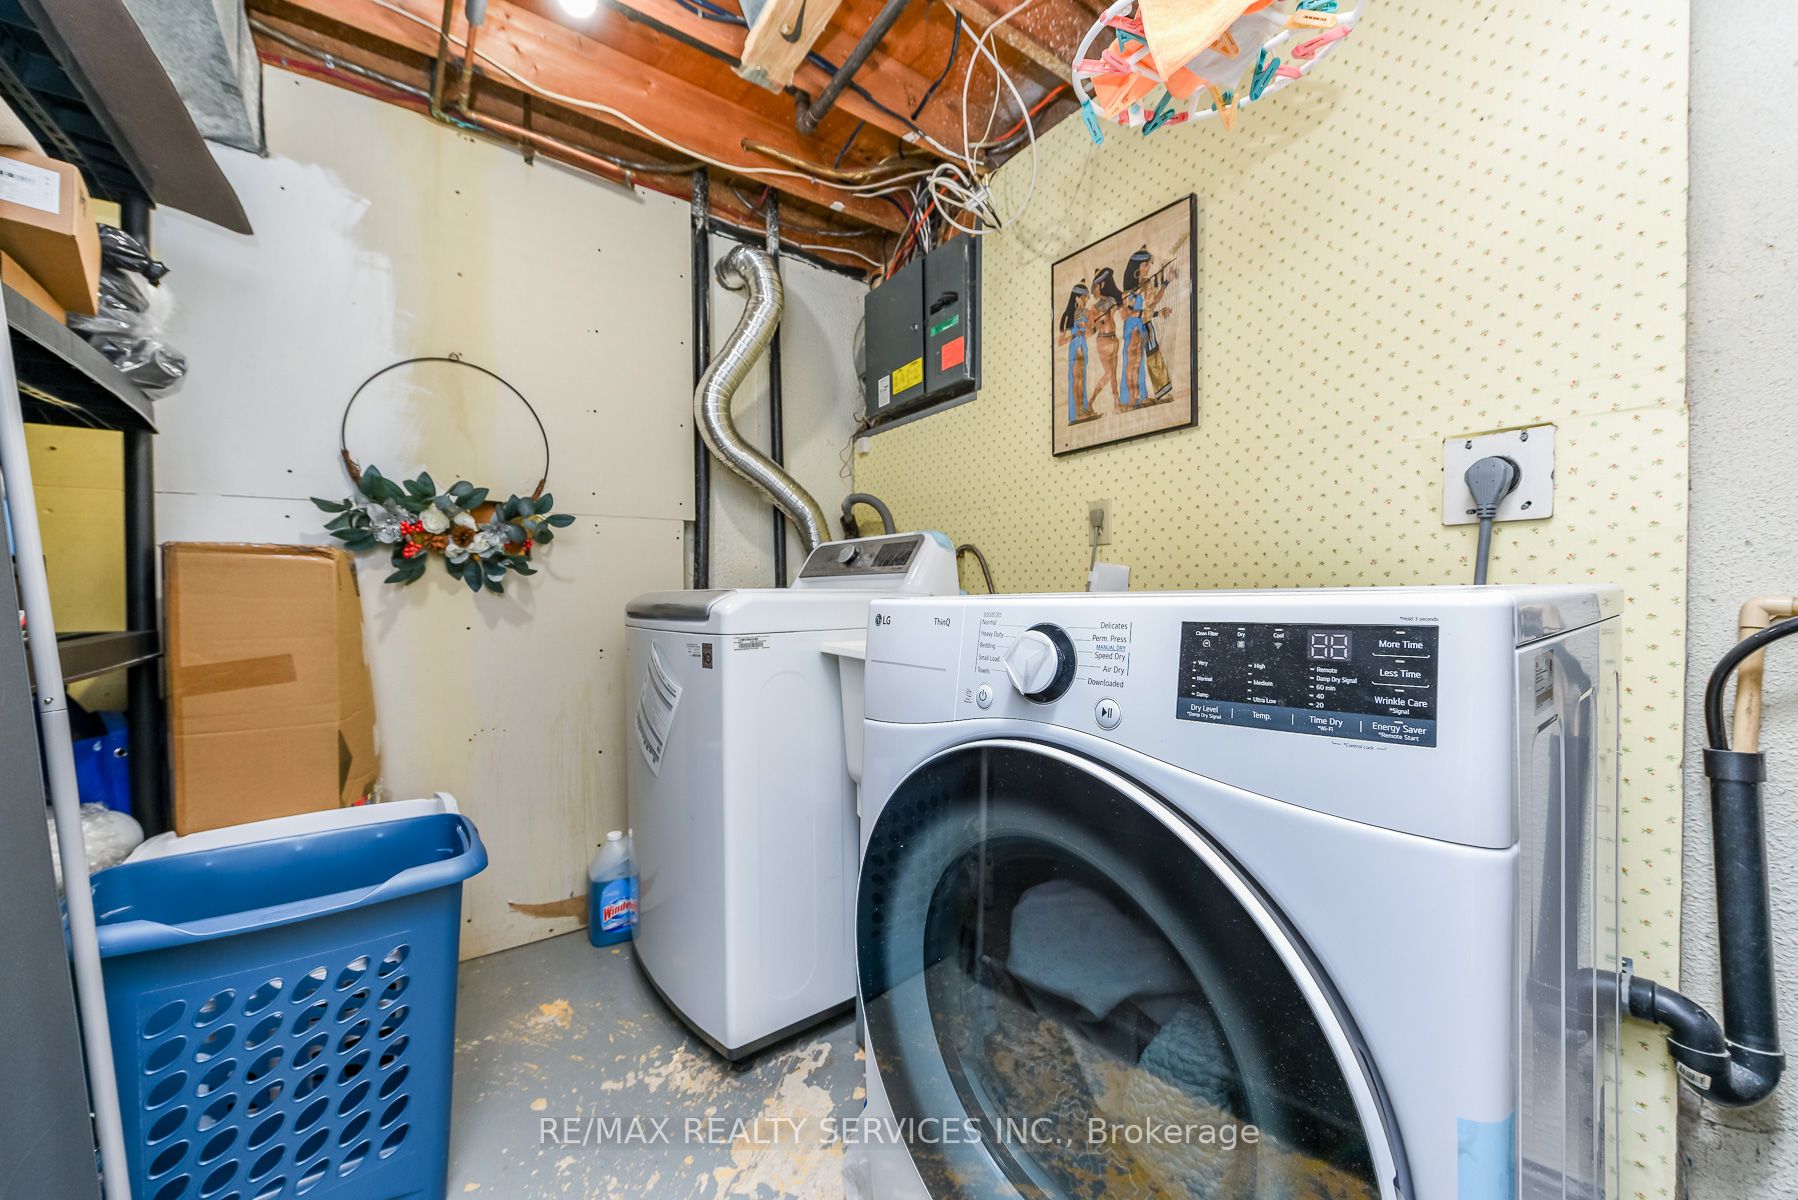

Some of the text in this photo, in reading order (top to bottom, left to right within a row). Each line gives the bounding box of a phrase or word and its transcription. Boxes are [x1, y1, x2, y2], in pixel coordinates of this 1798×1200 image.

[934, 617, 951, 627] ThinQ
[1100, 622, 1128, 630] Delicates
[981, 630, 1004, 639] Heavy Duty
[980, 641, 996, 650] Bedding
[1378, 640, 1423, 649] More Time
[1094, 652, 1126, 662] Speed Dry
[1114, 666, 1124, 676] Dry
[1379, 668, 1421, 679] Less Time
[1088, 678, 1124, 688] Downloaded
[1374, 696, 1428, 708] Wrinkle Care
[1190, 704, 1218, 713] Dry Level
[1252, 711, 1271, 721] Temp.
[1309, 716, 1343, 727] Time Dry
[1372, 722, 1427, 735] Energy Saver
